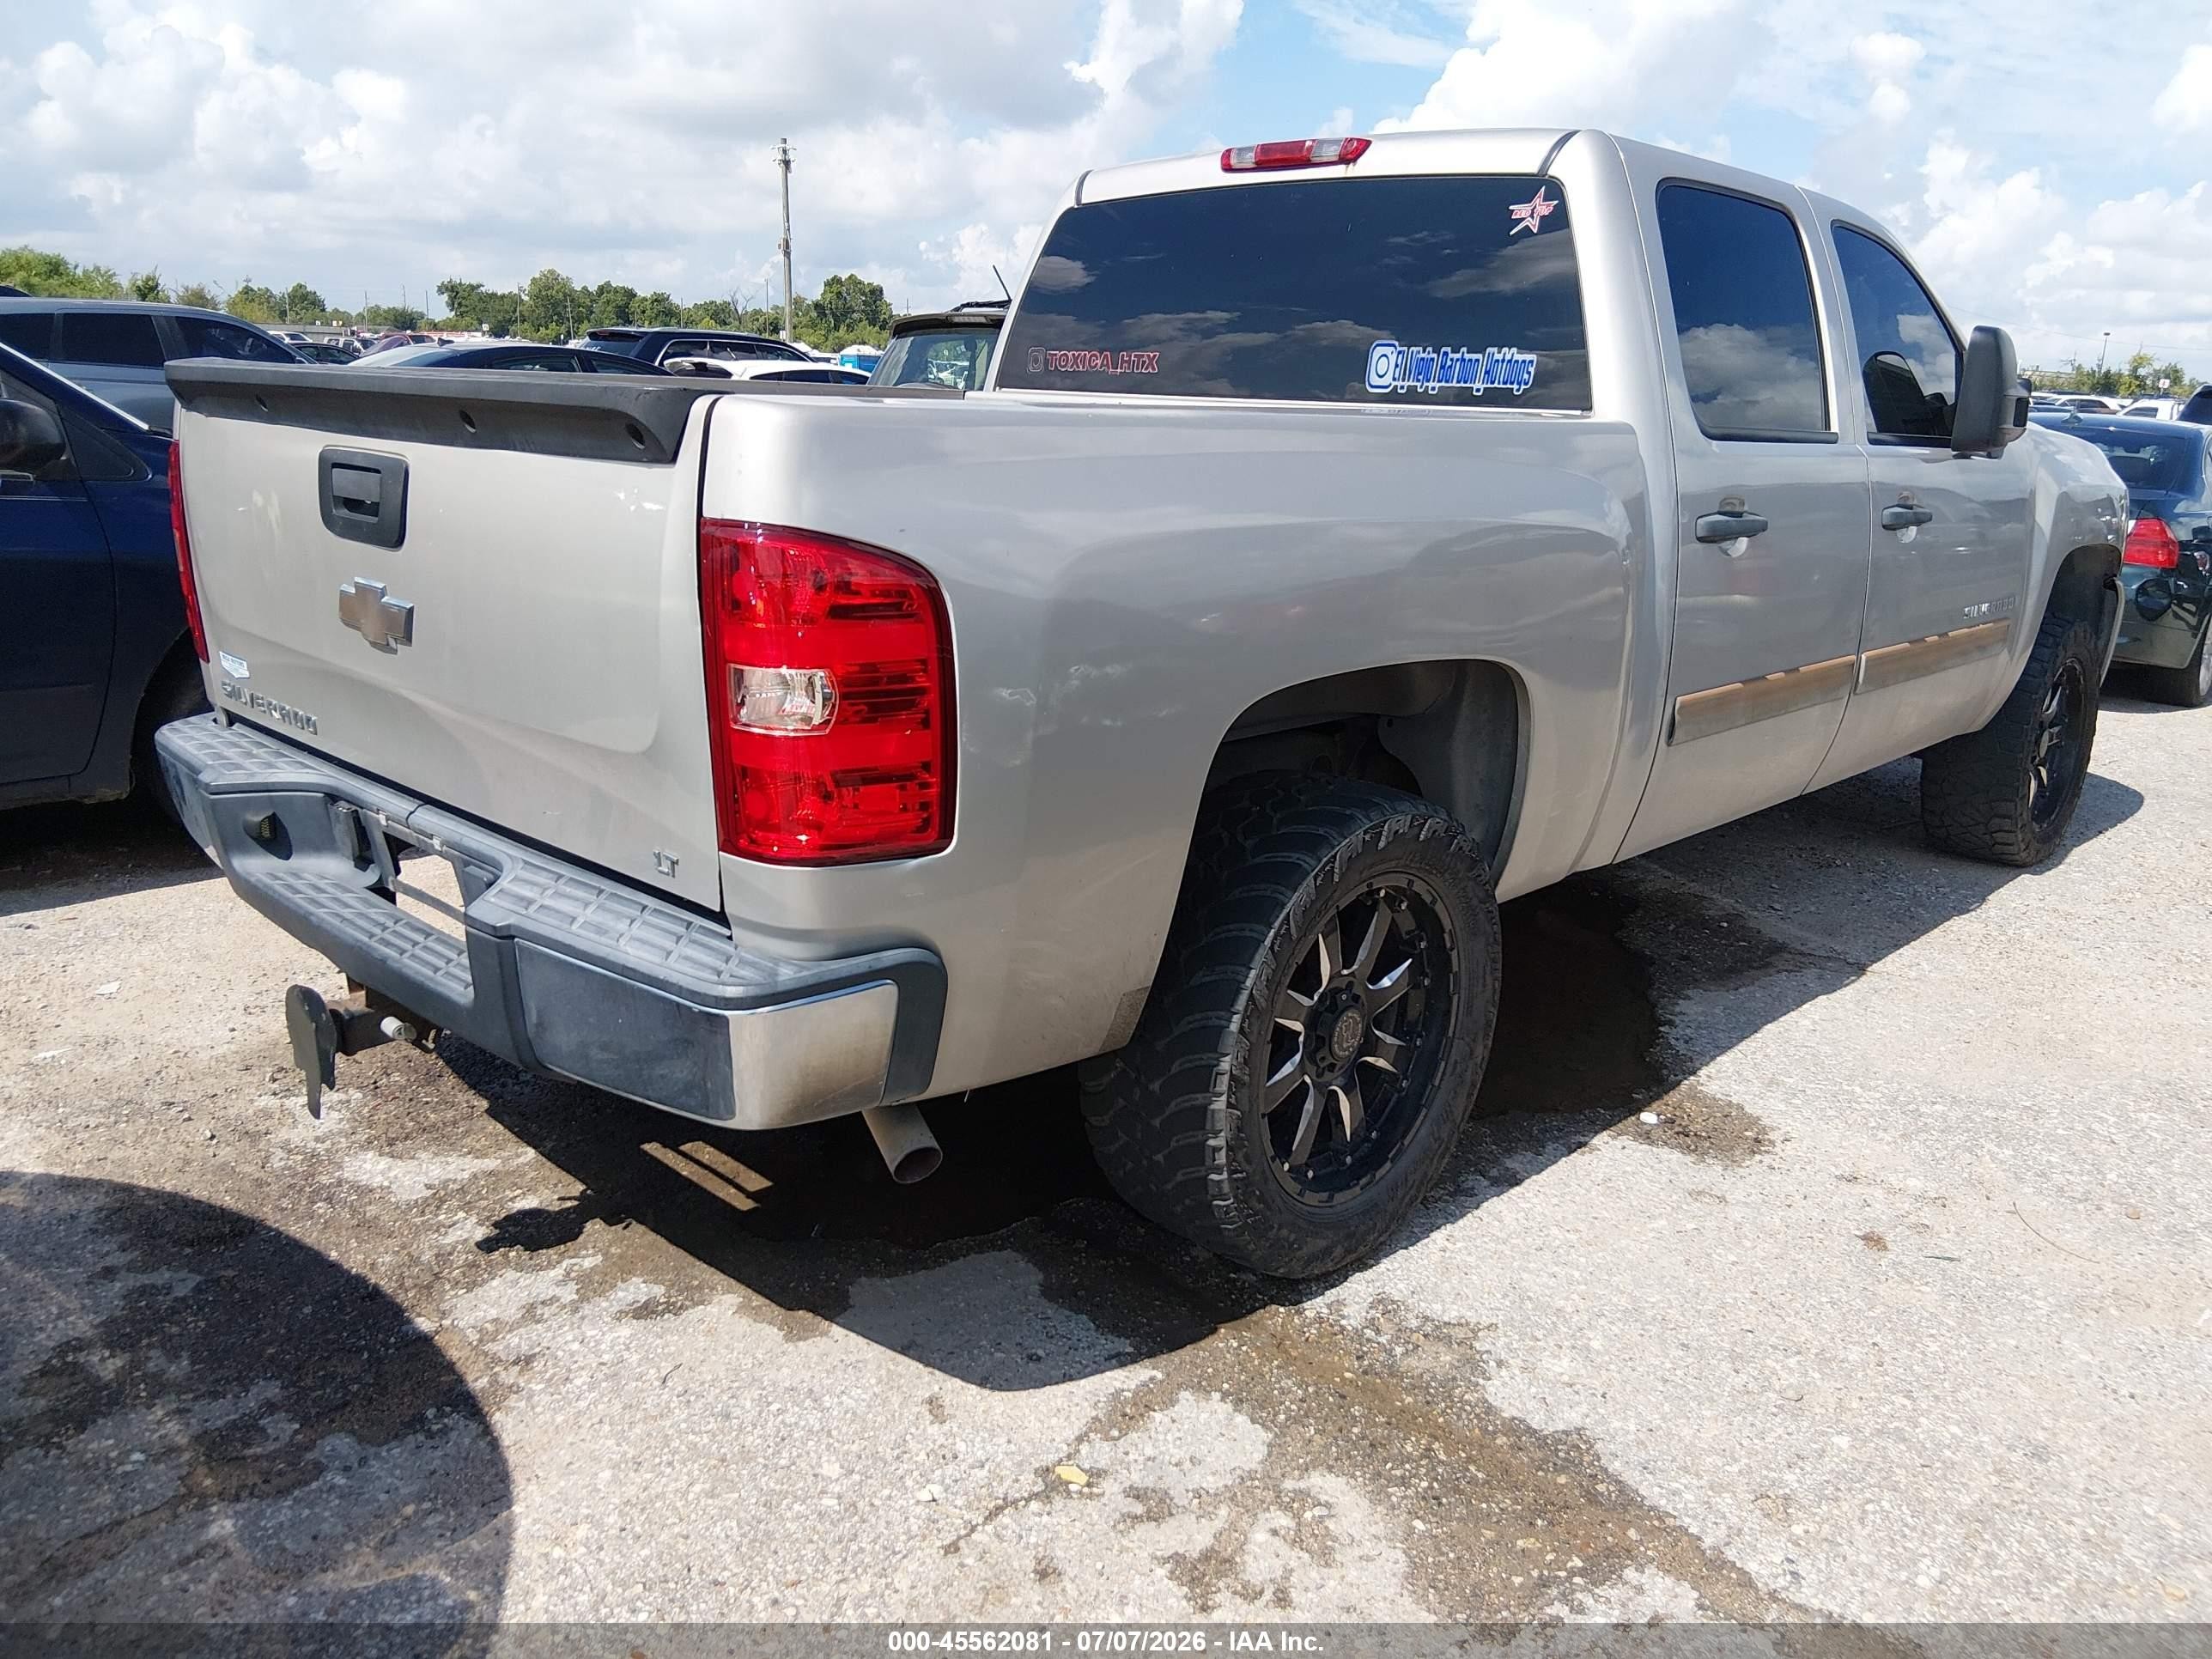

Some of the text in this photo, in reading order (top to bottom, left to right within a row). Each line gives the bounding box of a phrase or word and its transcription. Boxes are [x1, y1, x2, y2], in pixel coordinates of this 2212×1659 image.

[1047, 350, 1160, 375] TOXICA_HTX
[221, 680, 319, 736] SILVERADO
[653, 849, 679, 878] LT
